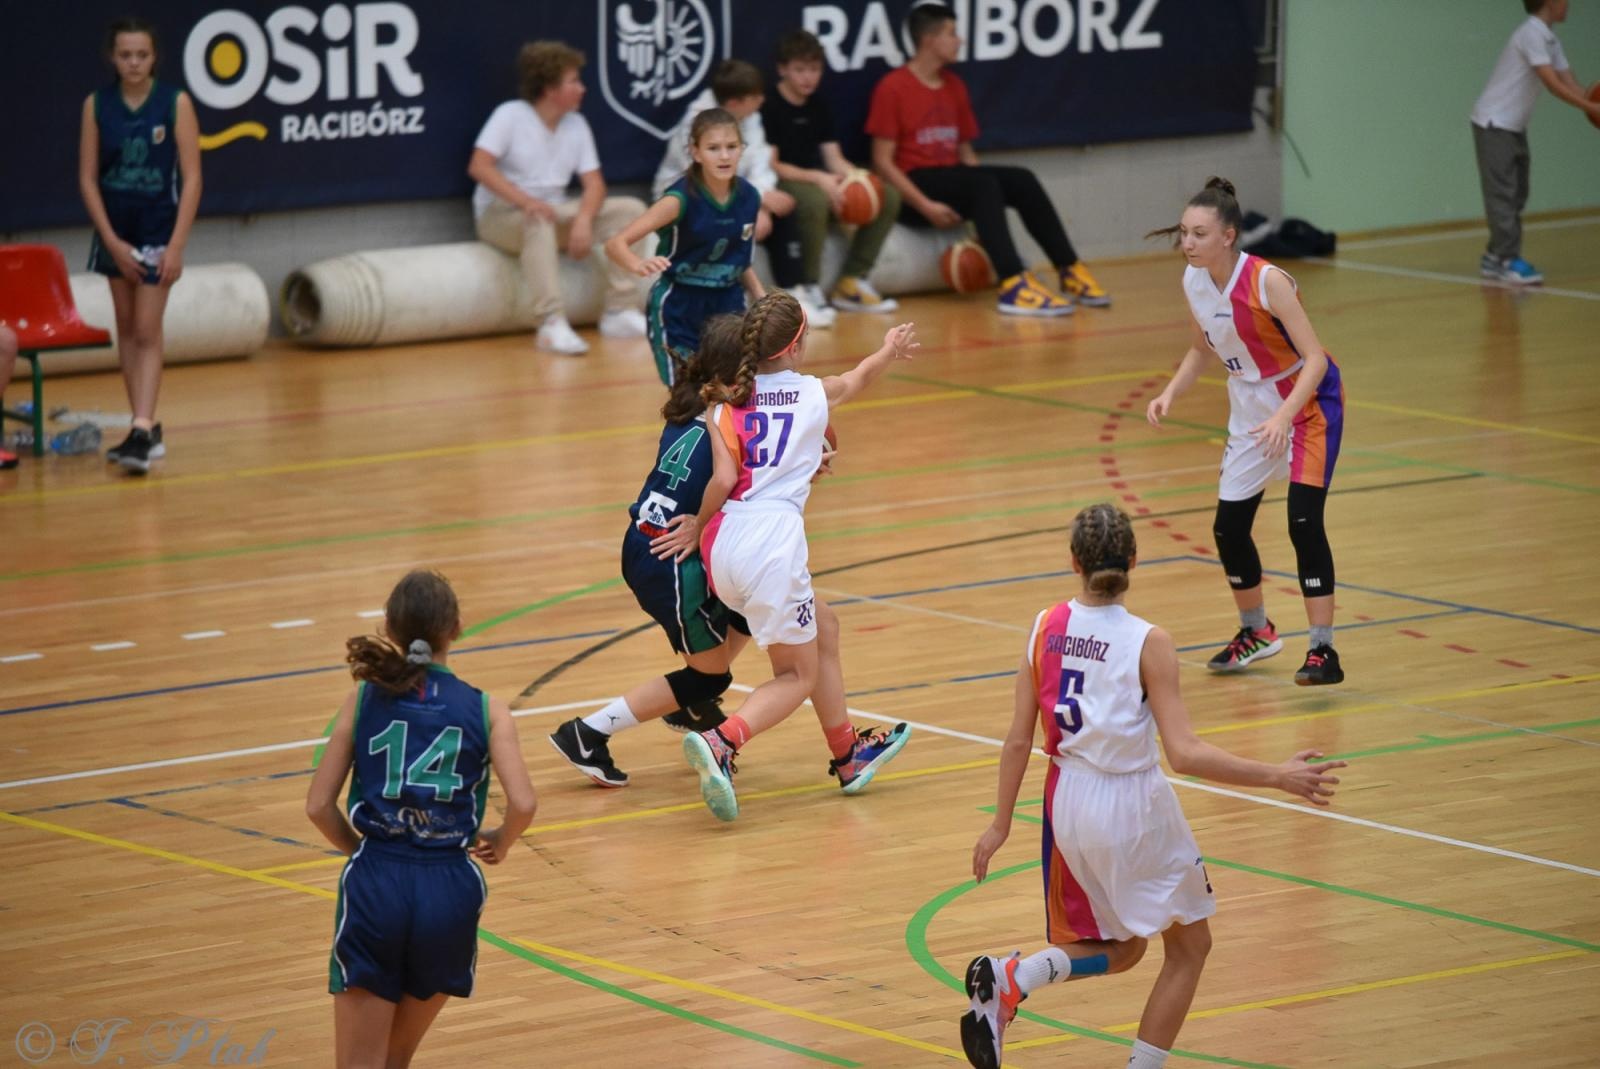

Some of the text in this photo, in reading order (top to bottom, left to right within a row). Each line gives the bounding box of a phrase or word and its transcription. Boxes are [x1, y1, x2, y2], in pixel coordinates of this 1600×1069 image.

[183, 3, 424, 110] OSiR
[281, 101, 424, 143] RACIBÓRZ
[657, 424, 706, 491] 4
[743, 411, 794, 469] 27
[1053, 668, 1085, 735] 5
[368, 719, 464, 803] 14
